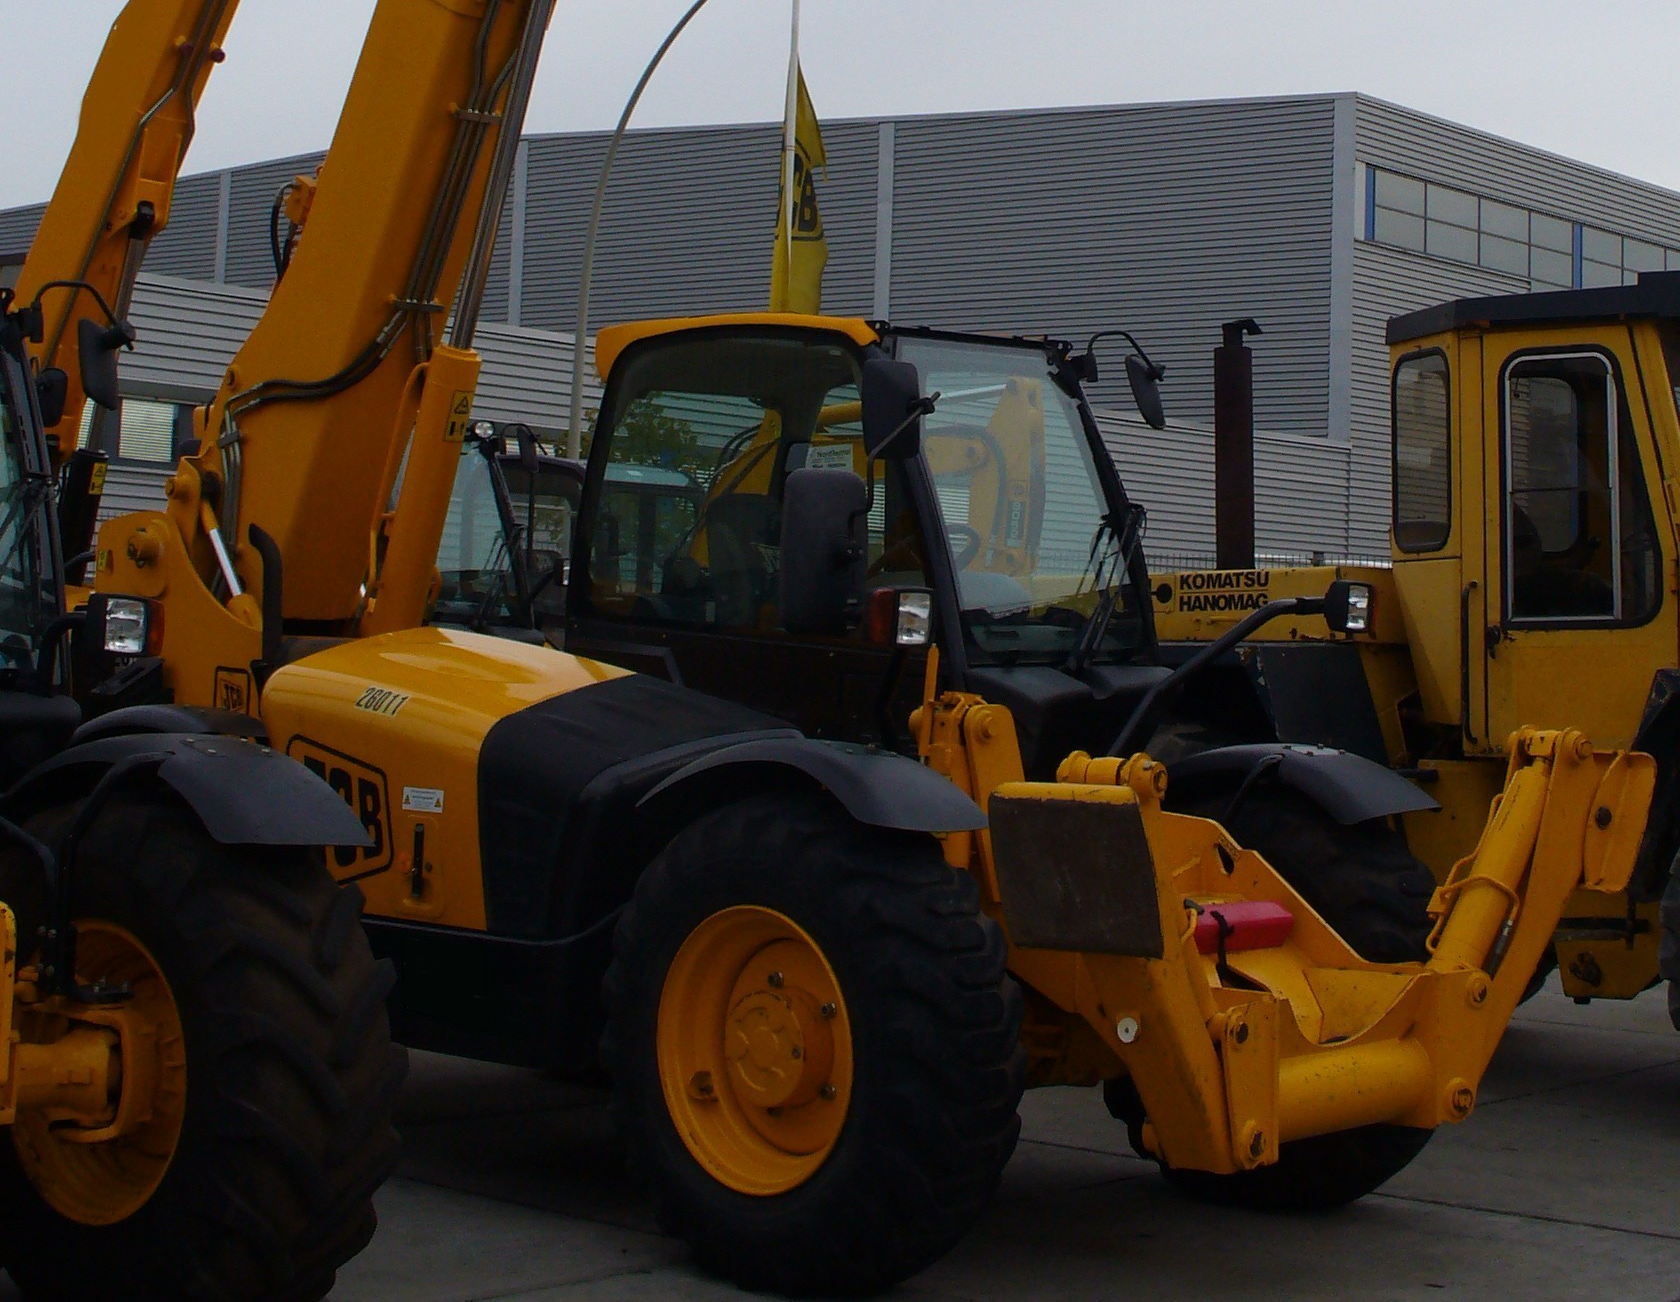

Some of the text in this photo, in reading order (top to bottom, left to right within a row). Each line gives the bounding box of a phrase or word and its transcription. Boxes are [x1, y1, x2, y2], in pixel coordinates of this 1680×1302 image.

[1179, 571, 1270, 590] KOMATSU
[1179, 592, 1269, 612] HANOMAG
[355, 687, 410, 715] 26011
